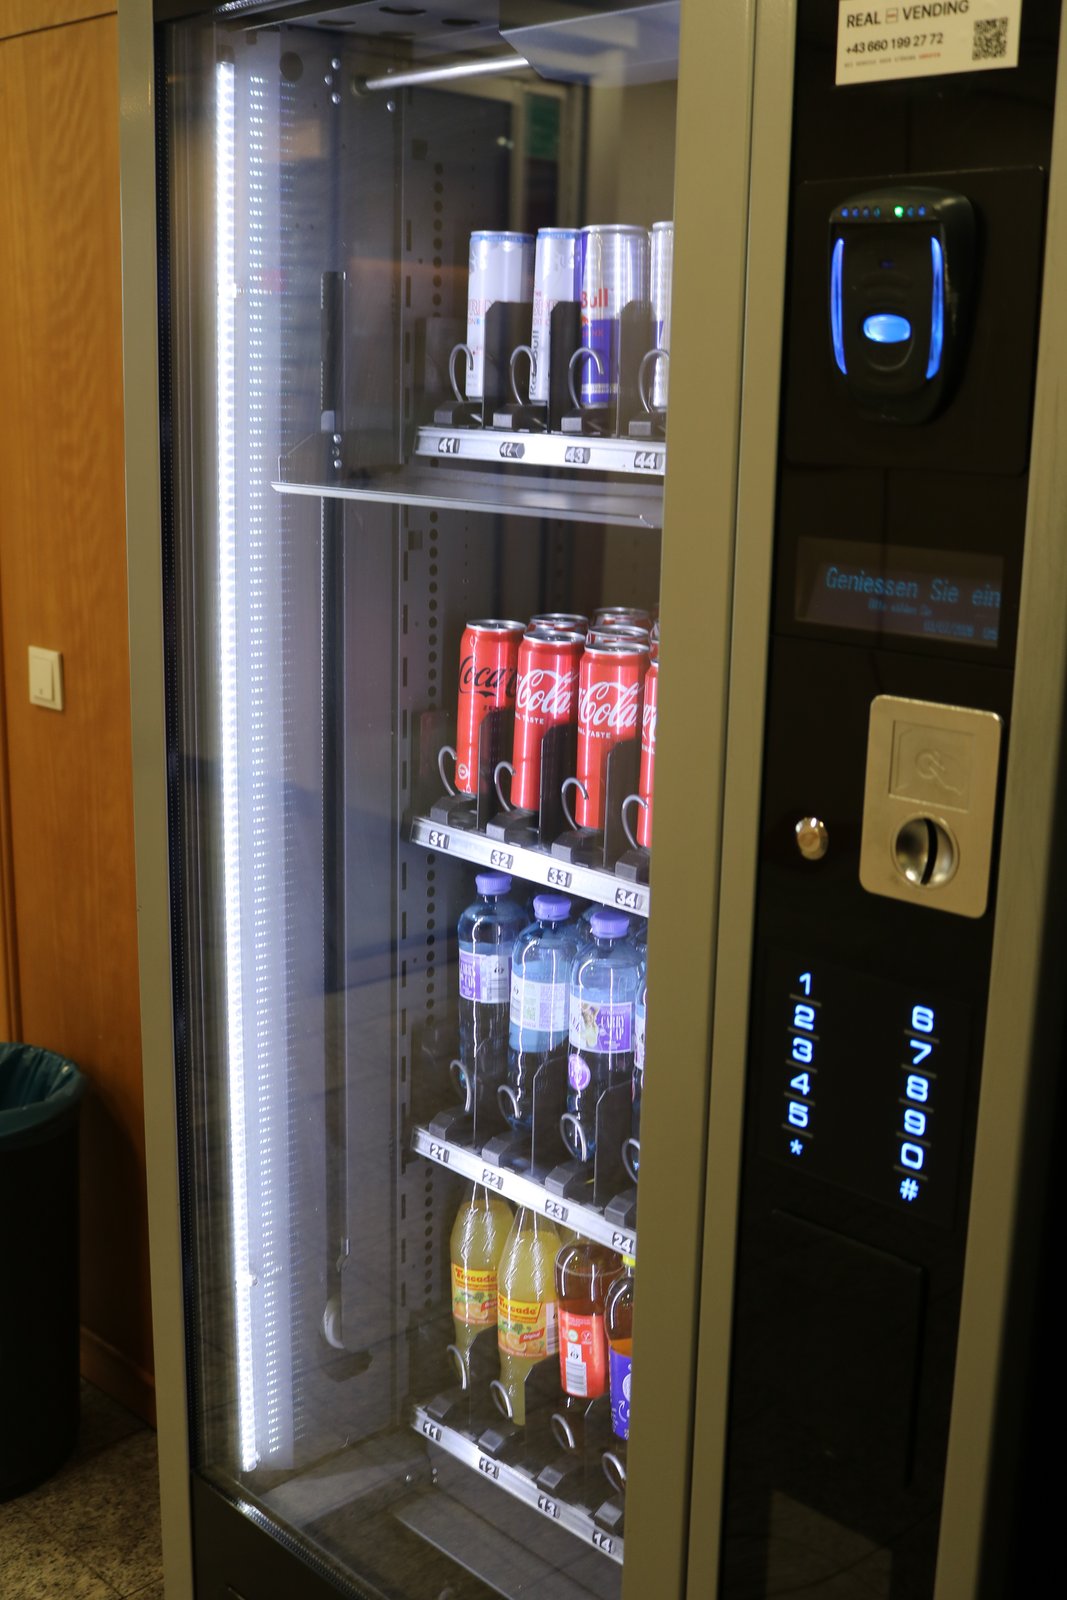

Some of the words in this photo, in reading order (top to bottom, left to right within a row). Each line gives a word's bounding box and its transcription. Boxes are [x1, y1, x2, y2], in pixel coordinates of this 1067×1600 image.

[846, 14, 881, 28] REAL
[902, 0, 969, 21] VENDING
[846, 41, 866, 54] +43
[867, 39, 888, 52] 660
[891, 36, 911, 50] 199
[913, 34, 927, 48] 27
[929, 33, 944, 45] 72
[437, 438, 456, 454] 41
[499, 442, 514, 458] 42
[565, 446, 585, 464] 43
[634, 451, 658, 469] 44
[826, 566, 918, 598] Geniessen
[930, 577, 960, 604] Sie
[429, 830, 446, 849] 31
[490, 850, 510, 869] 32
[547, 868, 568, 888] 33
[615, 888, 638, 909] 34
[799, 972, 811, 995] 1
[793, 1004, 815, 1030] 2
[911, 1005, 934, 1033] 6
[792, 1037, 813, 1063] 3
[909, 1039, 932, 1064] 7
[790, 1072, 810, 1095] 4
[906, 1074, 929, 1102] 8
[788, 1101, 808, 1128] 5
[903, 1108, 926, 1136] 9
[430, 1143, 446, 1162] 21
[900, 1142, 924, 1170] 0
[482, 1169, 501, 1188] 22
[545, 1199, 564, 1220] 23
[613, 1232, 634, 1254] 24
[422, 1420, 439, 1441] 11
[479, 1456, 497, 1479] 12
[537, 1496, 558, 1518] 13
[592, 1530, 613, 1553] 14
